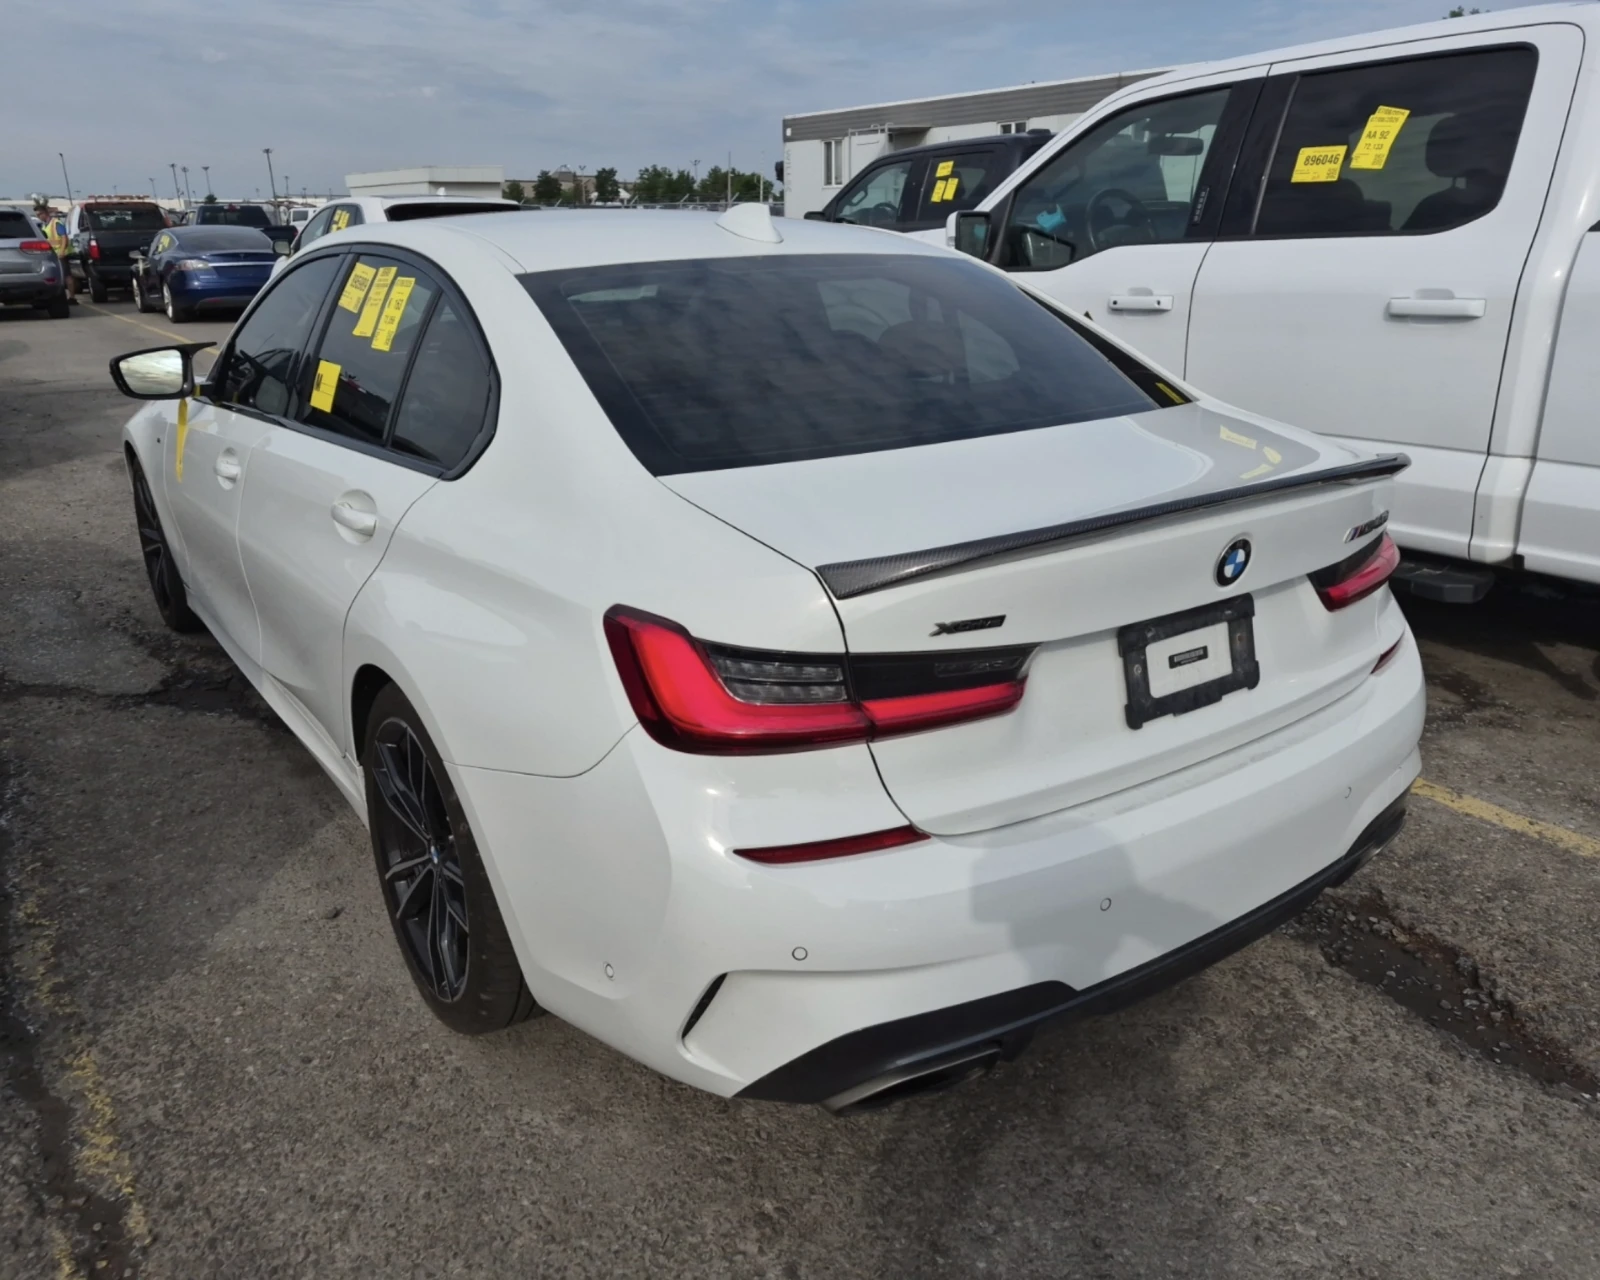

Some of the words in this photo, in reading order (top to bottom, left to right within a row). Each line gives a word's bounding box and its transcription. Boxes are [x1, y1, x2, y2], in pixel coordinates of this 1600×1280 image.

[1366, 131, 1377, 139] AA
[1379, 130, 1390, 140] 92
[1304, 153, 1340, 166] 896046
